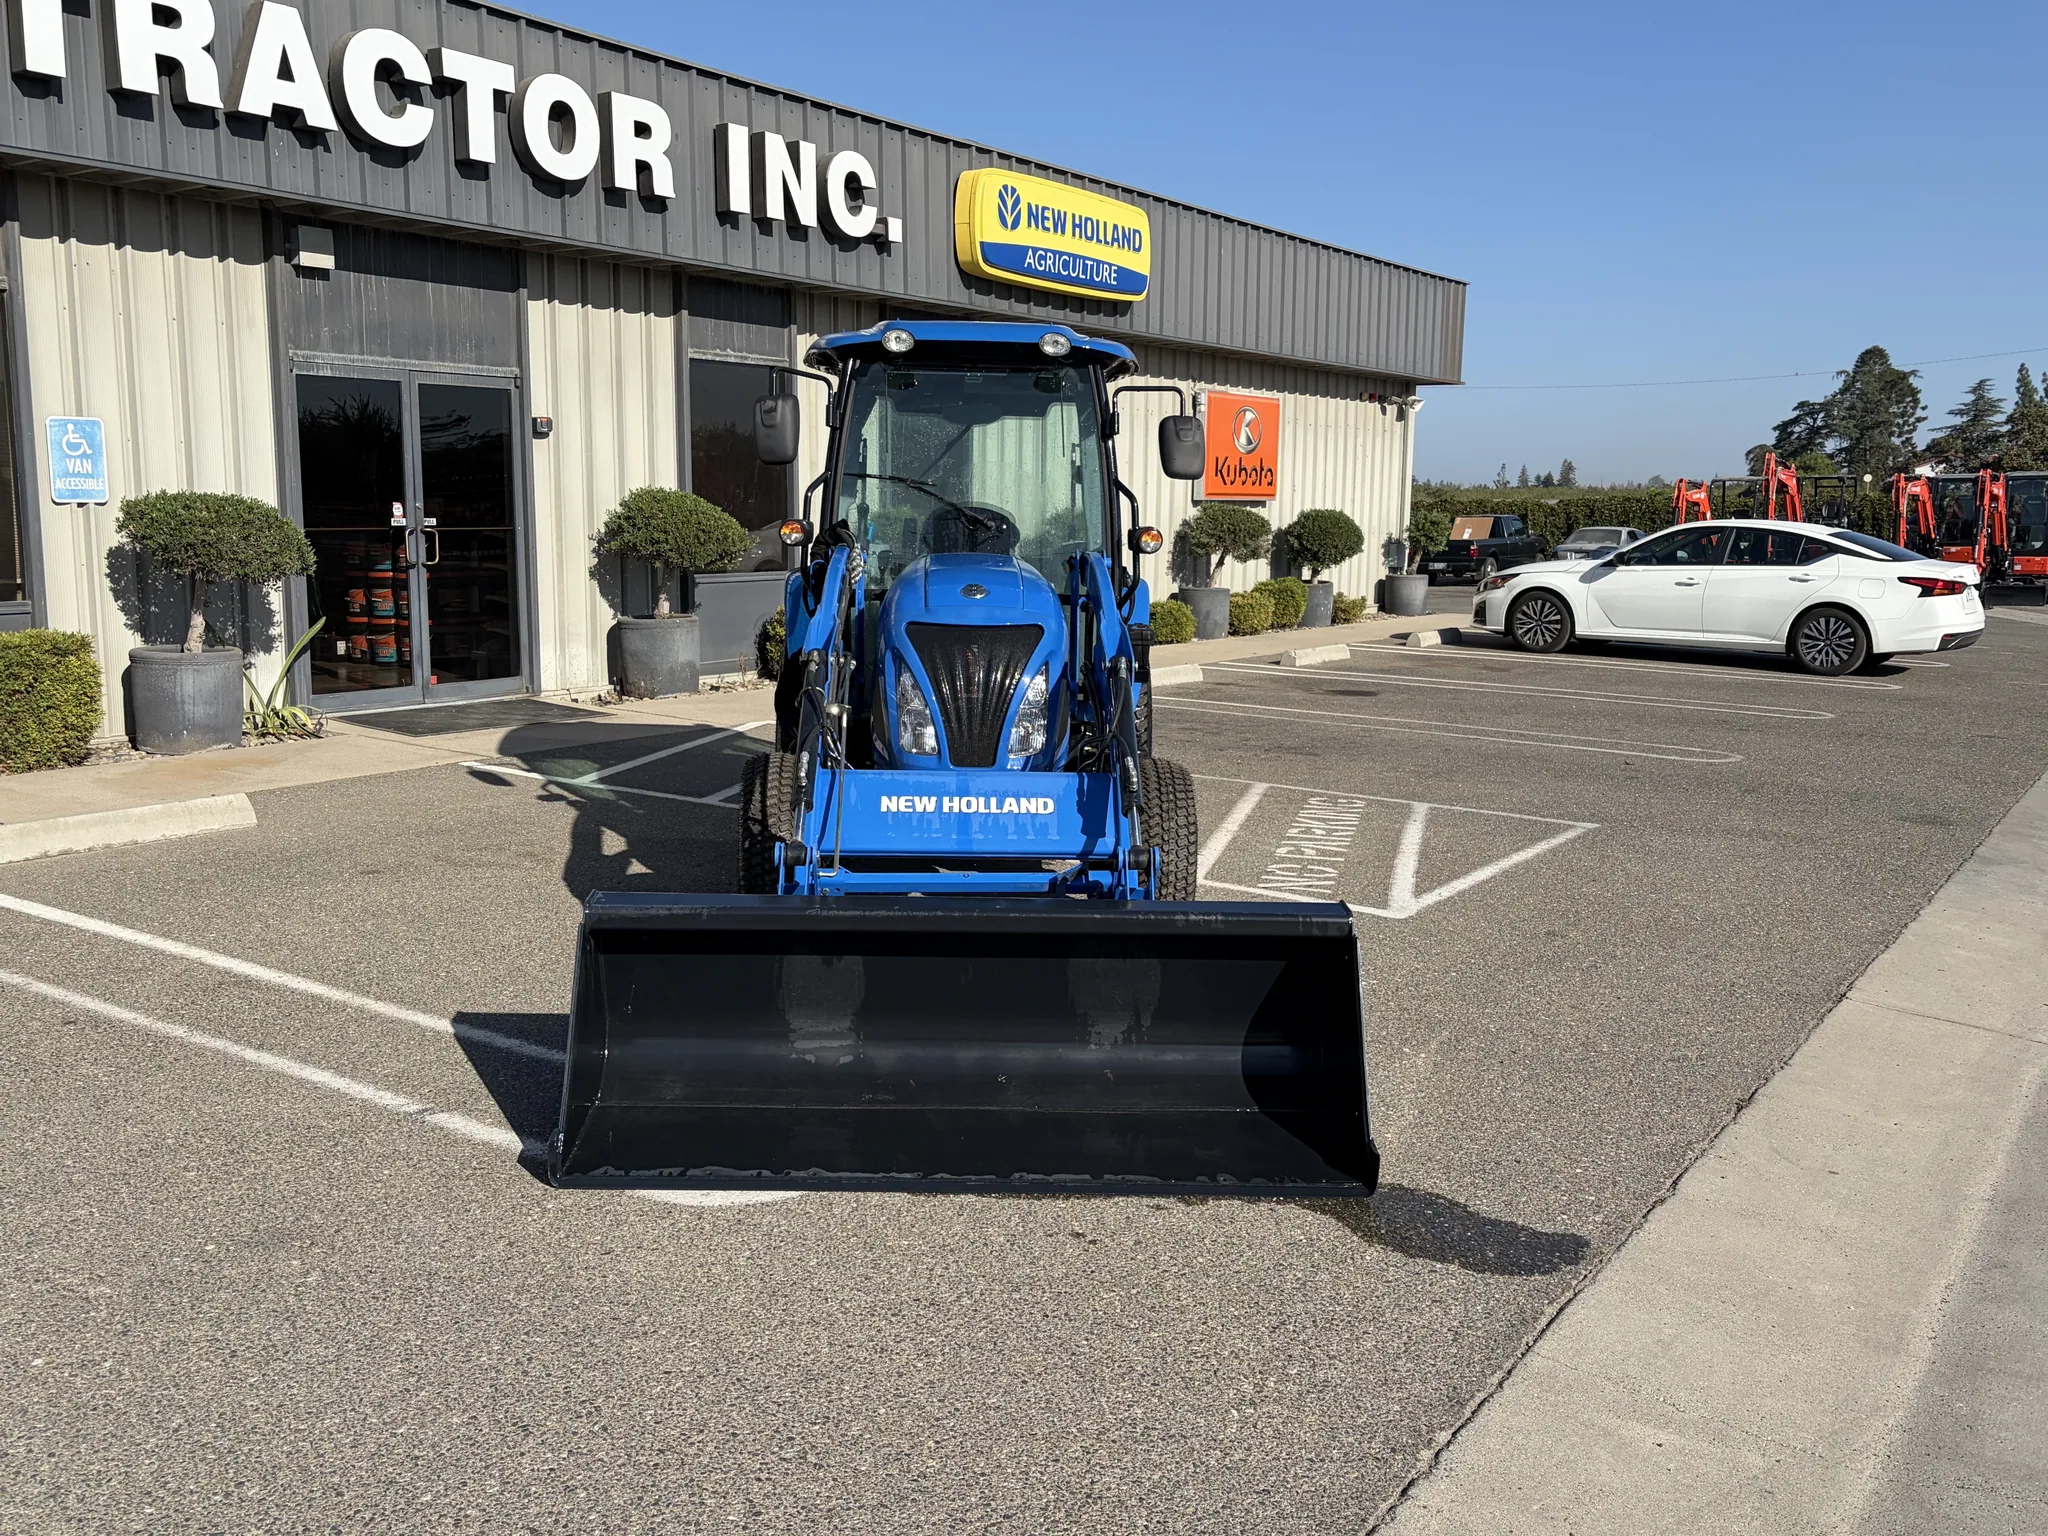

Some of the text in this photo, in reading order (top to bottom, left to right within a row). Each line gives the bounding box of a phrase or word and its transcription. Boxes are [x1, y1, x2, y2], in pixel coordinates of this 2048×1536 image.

[716, 122, 903, 243] INC.
[1027, 202, 1142, 253] NEW HOLLAND
[1025, 248, 1118, 285] AGRICULTURE
[65, 458, 92, 474] VAN
[1215, 456, 1274, 486] Kubota
[55, 477, 104, 490] ACCESSIBLE
[880, 795, 1055, 815] NEW HOLLAND
